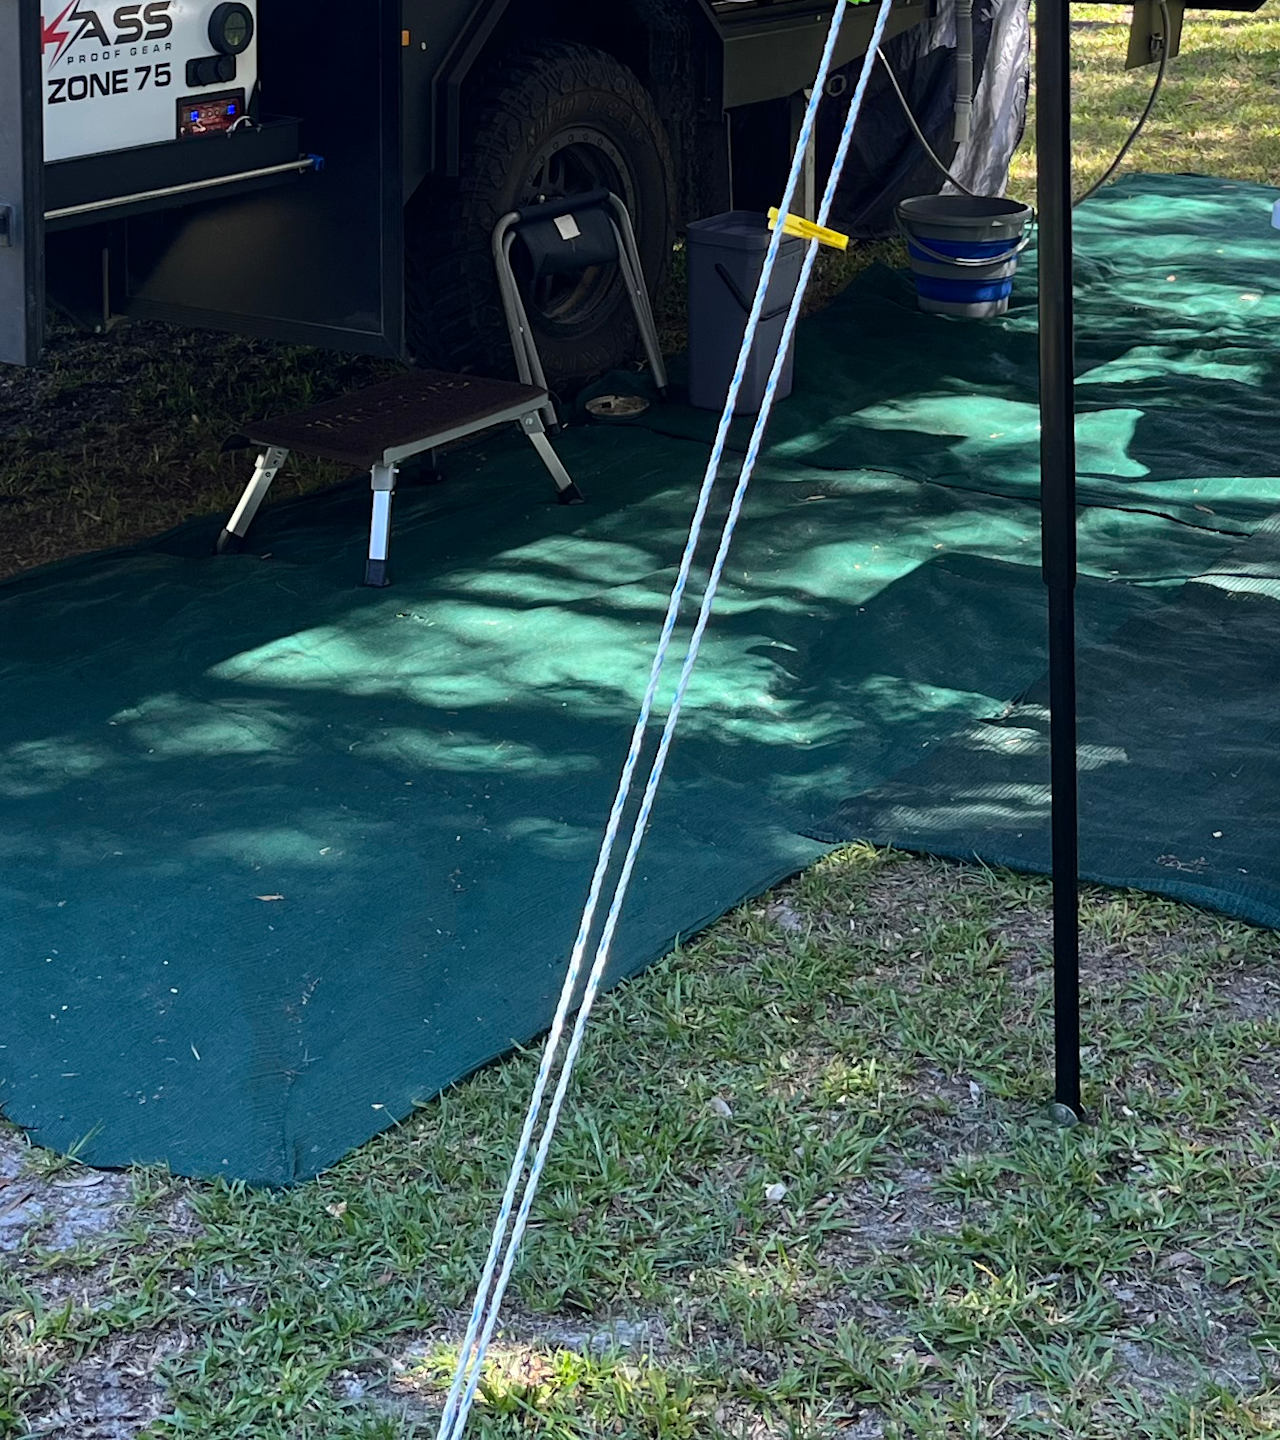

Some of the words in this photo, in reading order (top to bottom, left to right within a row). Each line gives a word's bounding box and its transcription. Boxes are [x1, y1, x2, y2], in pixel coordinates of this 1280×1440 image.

[67, 50, 122, 65] PROOF
[130, 42, 173, 57] GEAR
[47, 68, 129, 105] ZONE
[134, 62, 171, 91] 75
